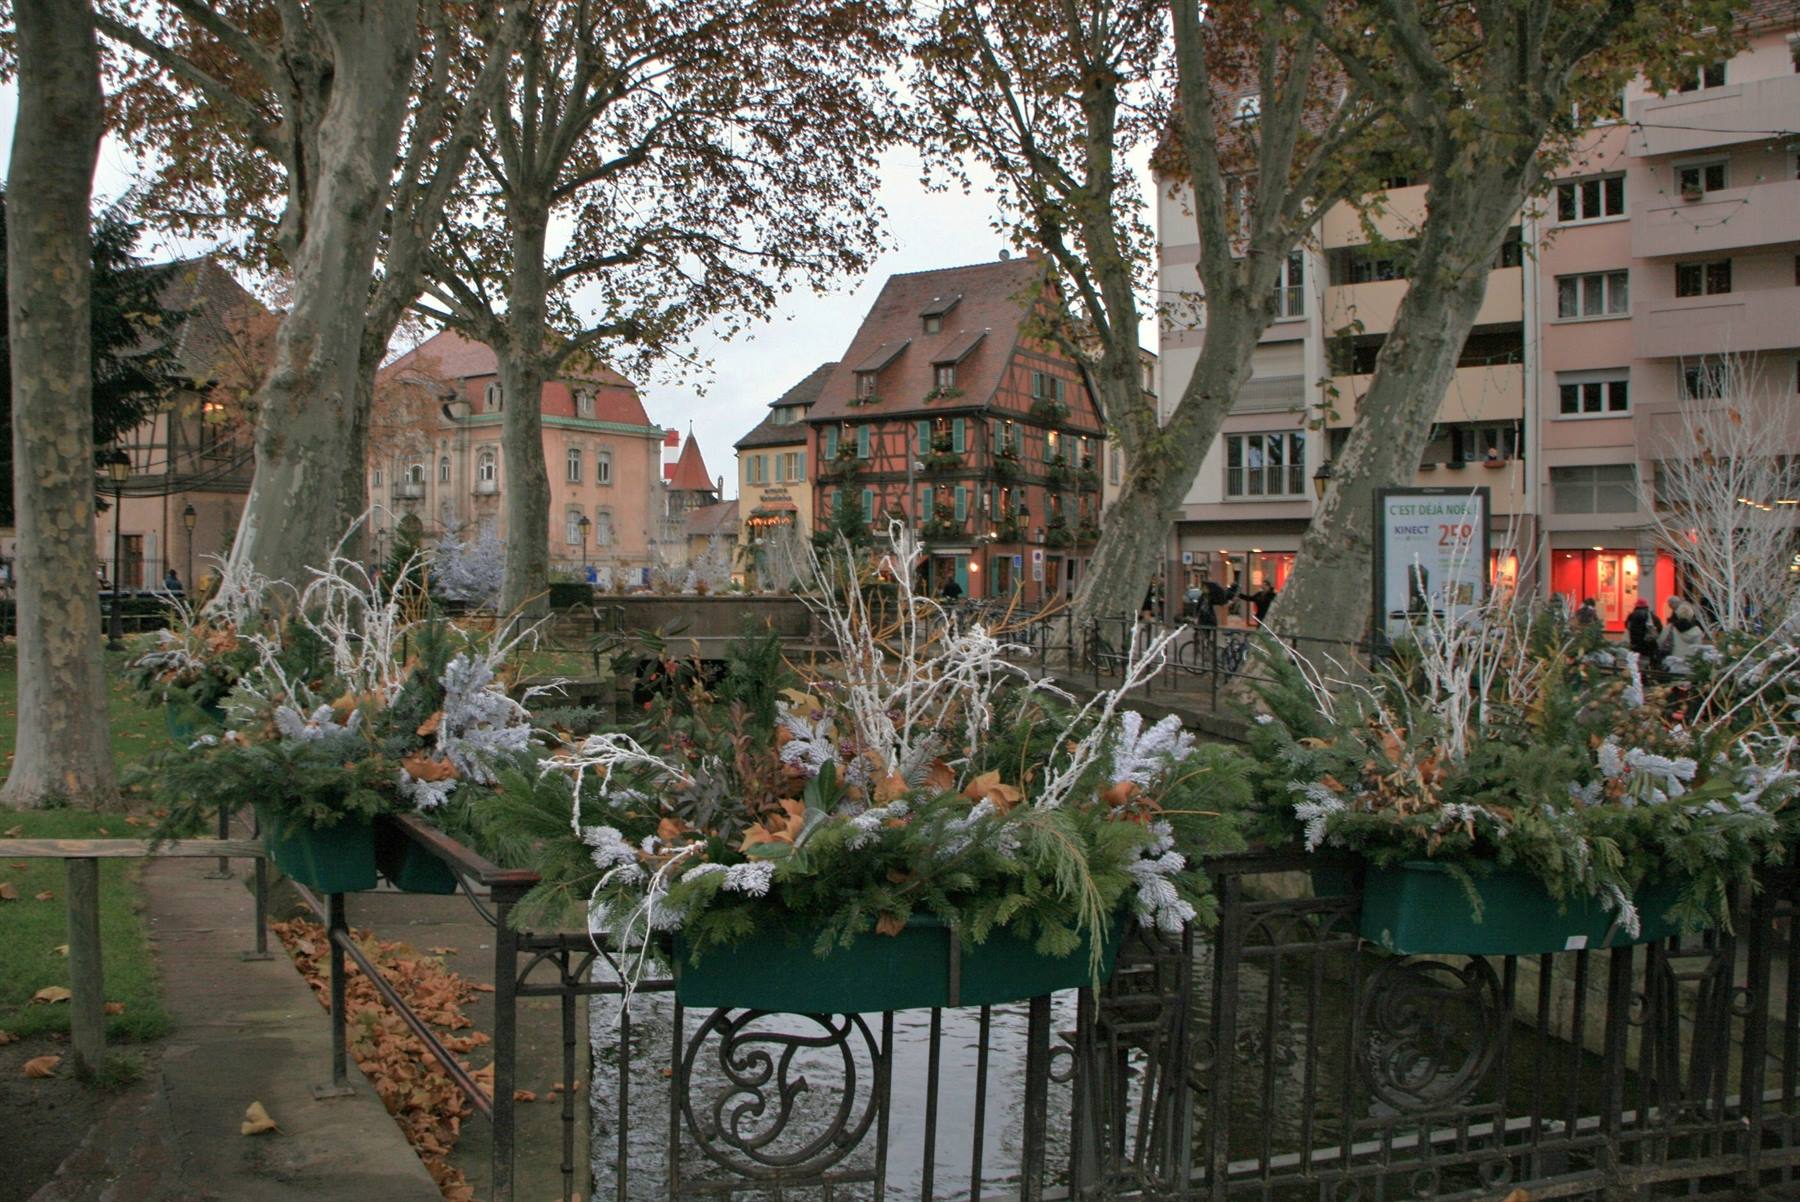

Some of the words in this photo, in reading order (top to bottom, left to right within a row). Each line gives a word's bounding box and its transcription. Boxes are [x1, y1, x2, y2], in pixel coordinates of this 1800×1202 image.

[1390, 504, 1416, 515] C'EST
[1419, 502, 1444, 515] DÉJÀ
[1394, 525, 1430, 535] KINECT
